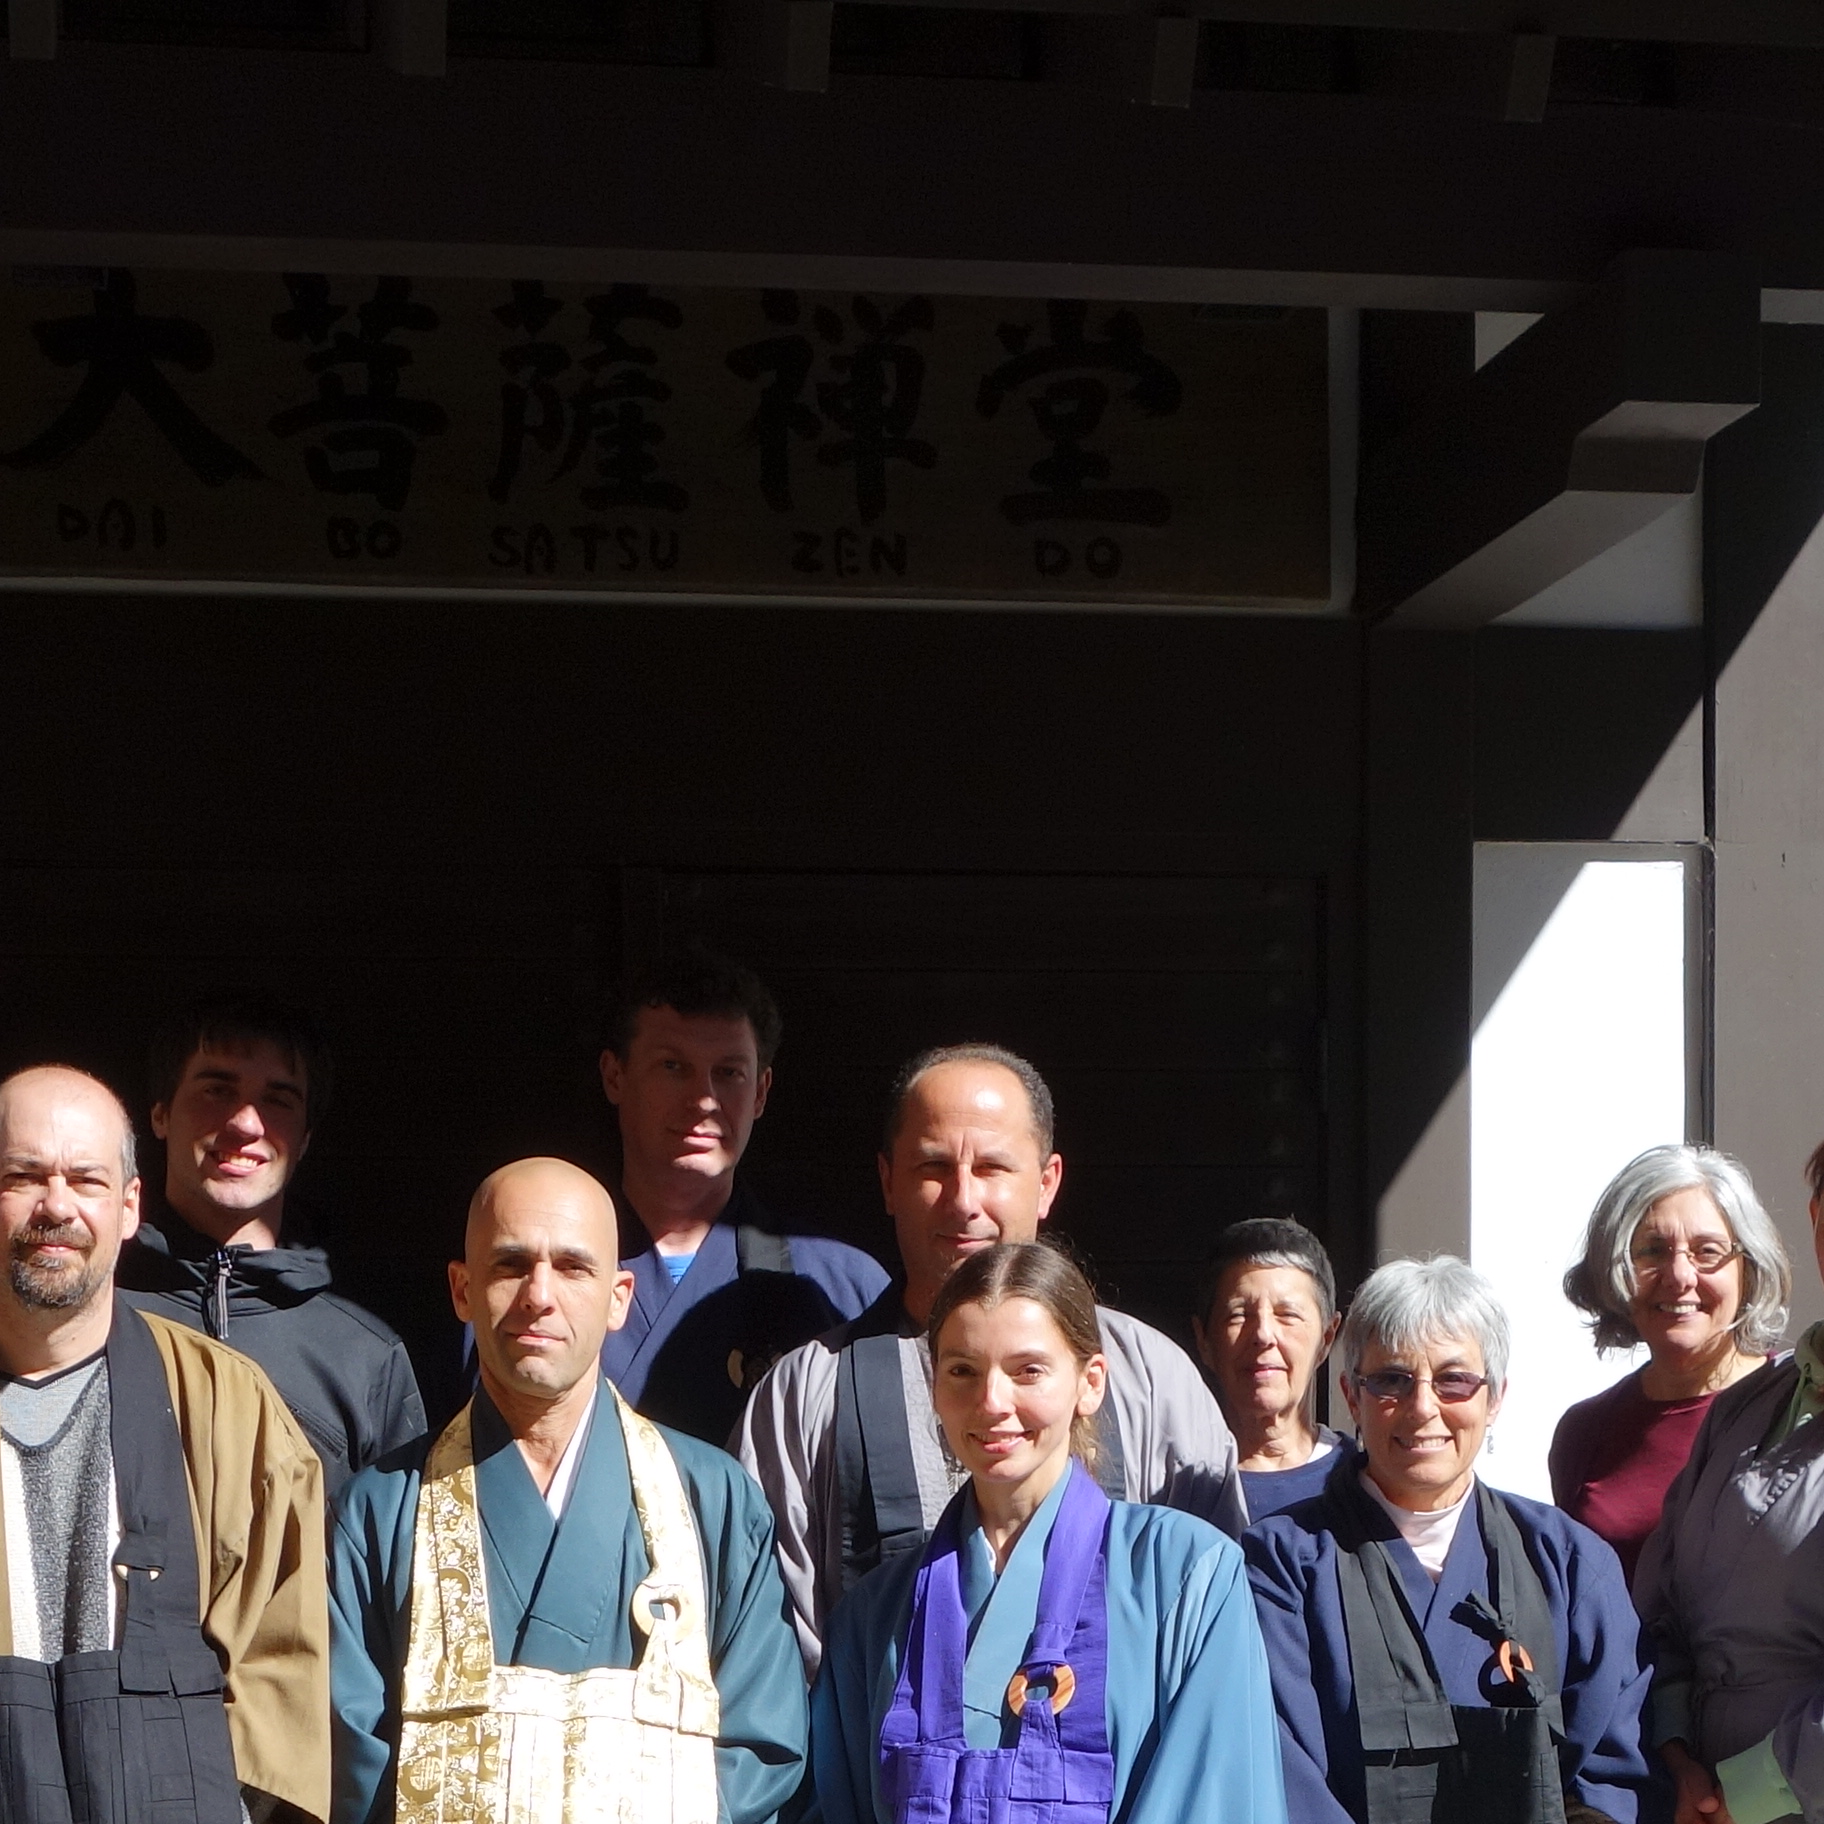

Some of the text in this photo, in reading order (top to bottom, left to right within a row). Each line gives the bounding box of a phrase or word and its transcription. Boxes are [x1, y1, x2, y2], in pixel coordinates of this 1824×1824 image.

[56, 499, 1144, 580] DAI BO SATSU ZEN DO
